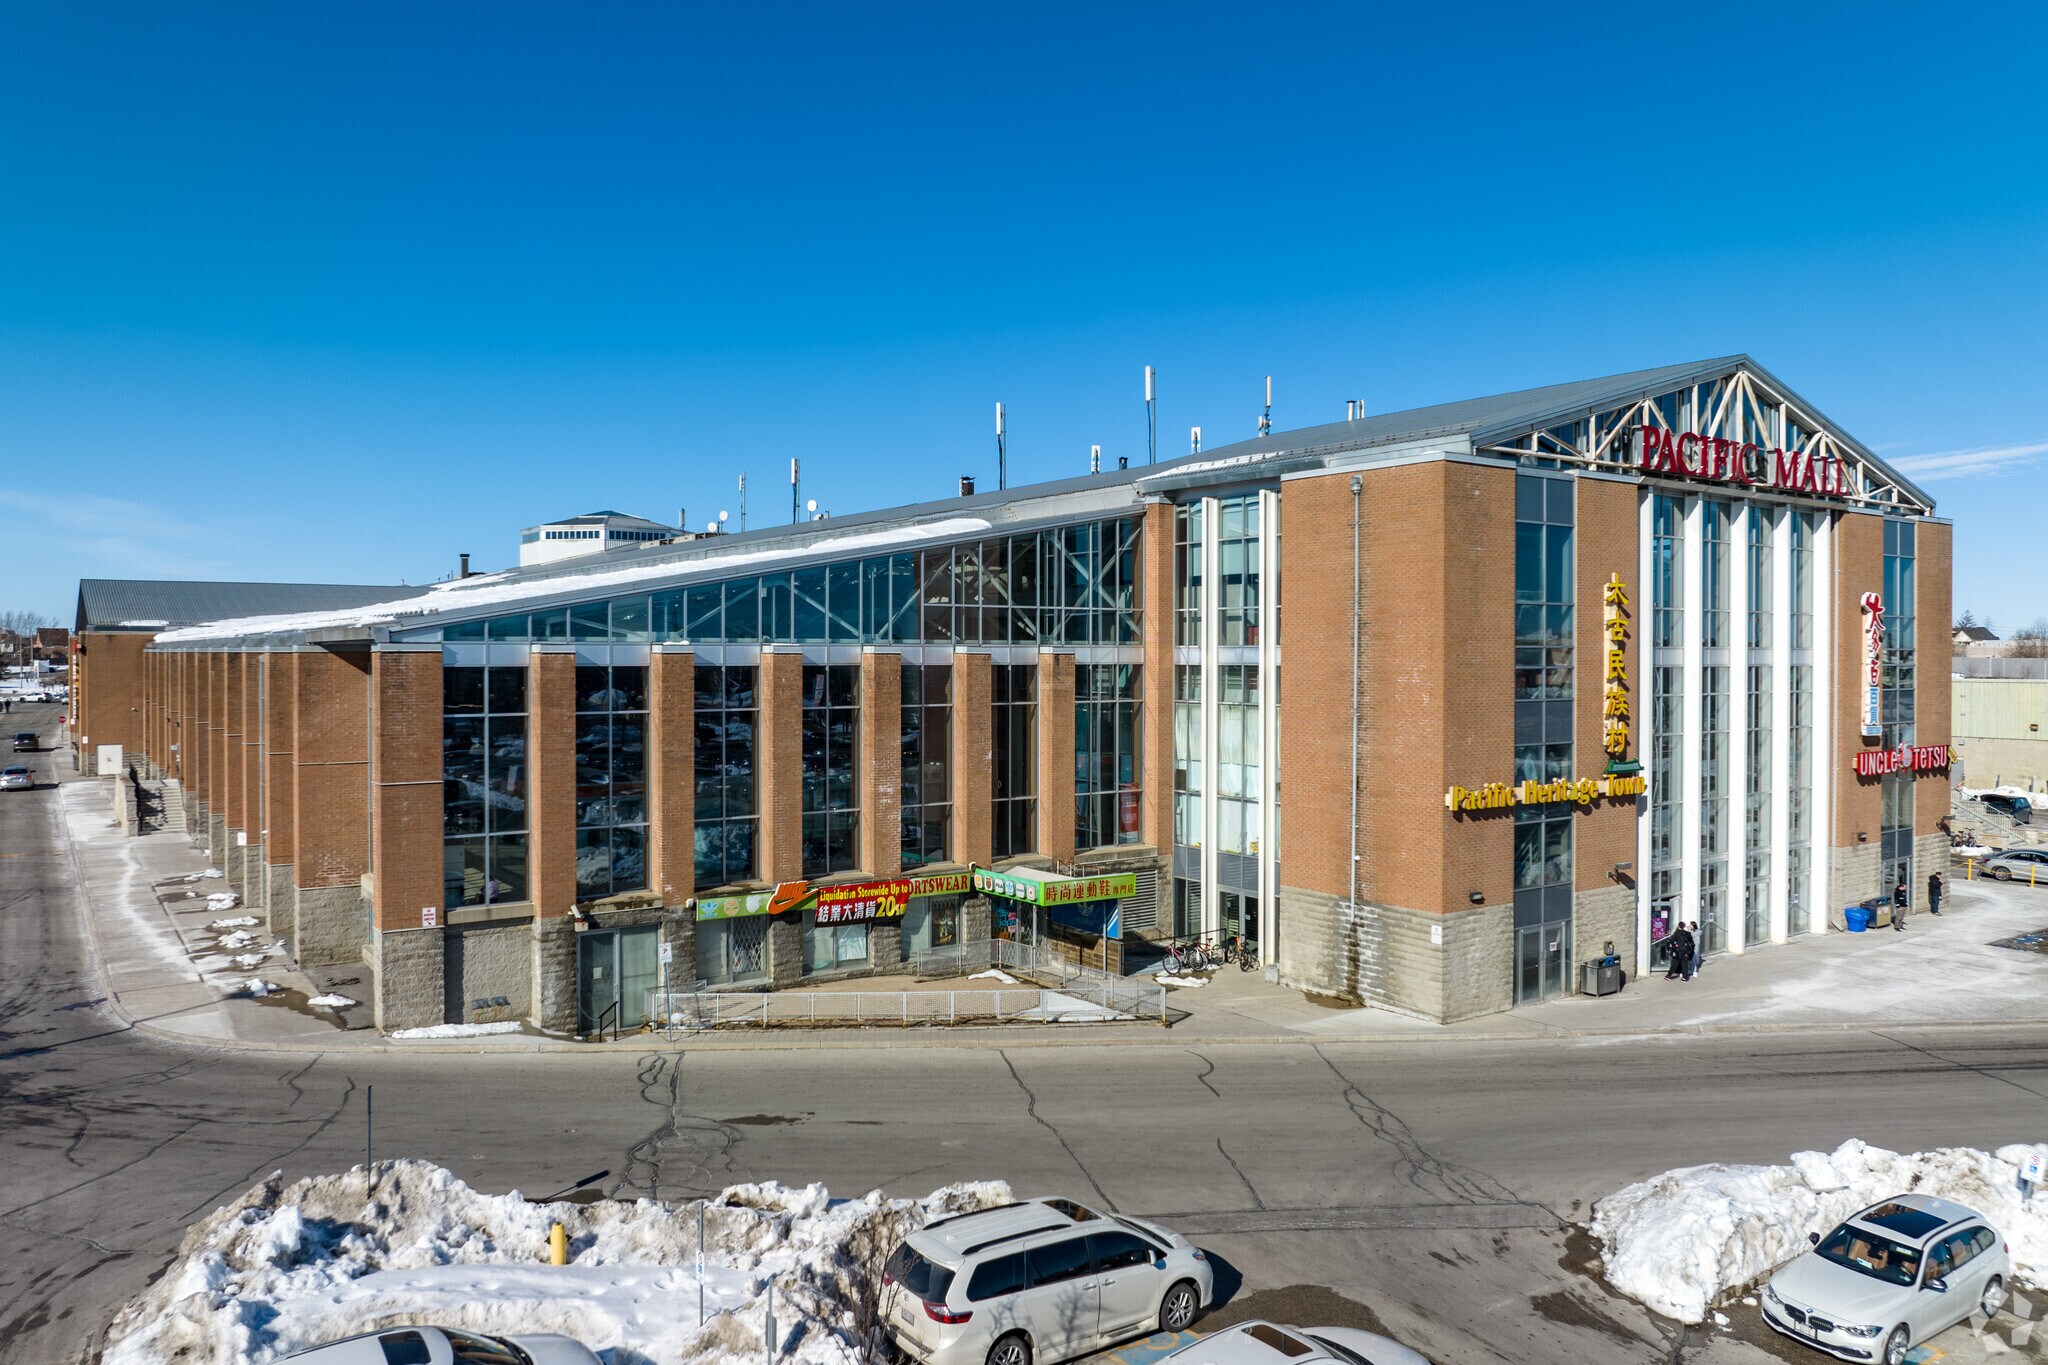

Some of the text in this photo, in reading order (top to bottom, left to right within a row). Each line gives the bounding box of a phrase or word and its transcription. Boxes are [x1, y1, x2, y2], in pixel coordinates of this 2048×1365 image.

[1639, 425, 1849, 496] PACIFIC MALL
[1606, 572, 1629, 753] 太古民族村
[1451, 774, 1645, 811] Pacific Heritage Town
[890, 883, 900, 896] Up
[901, 884, 909, 893] to
[909, 875, 968, 895] ORTSWEAR
[1045, 880, 1111, 902] 時尚運動鞋
